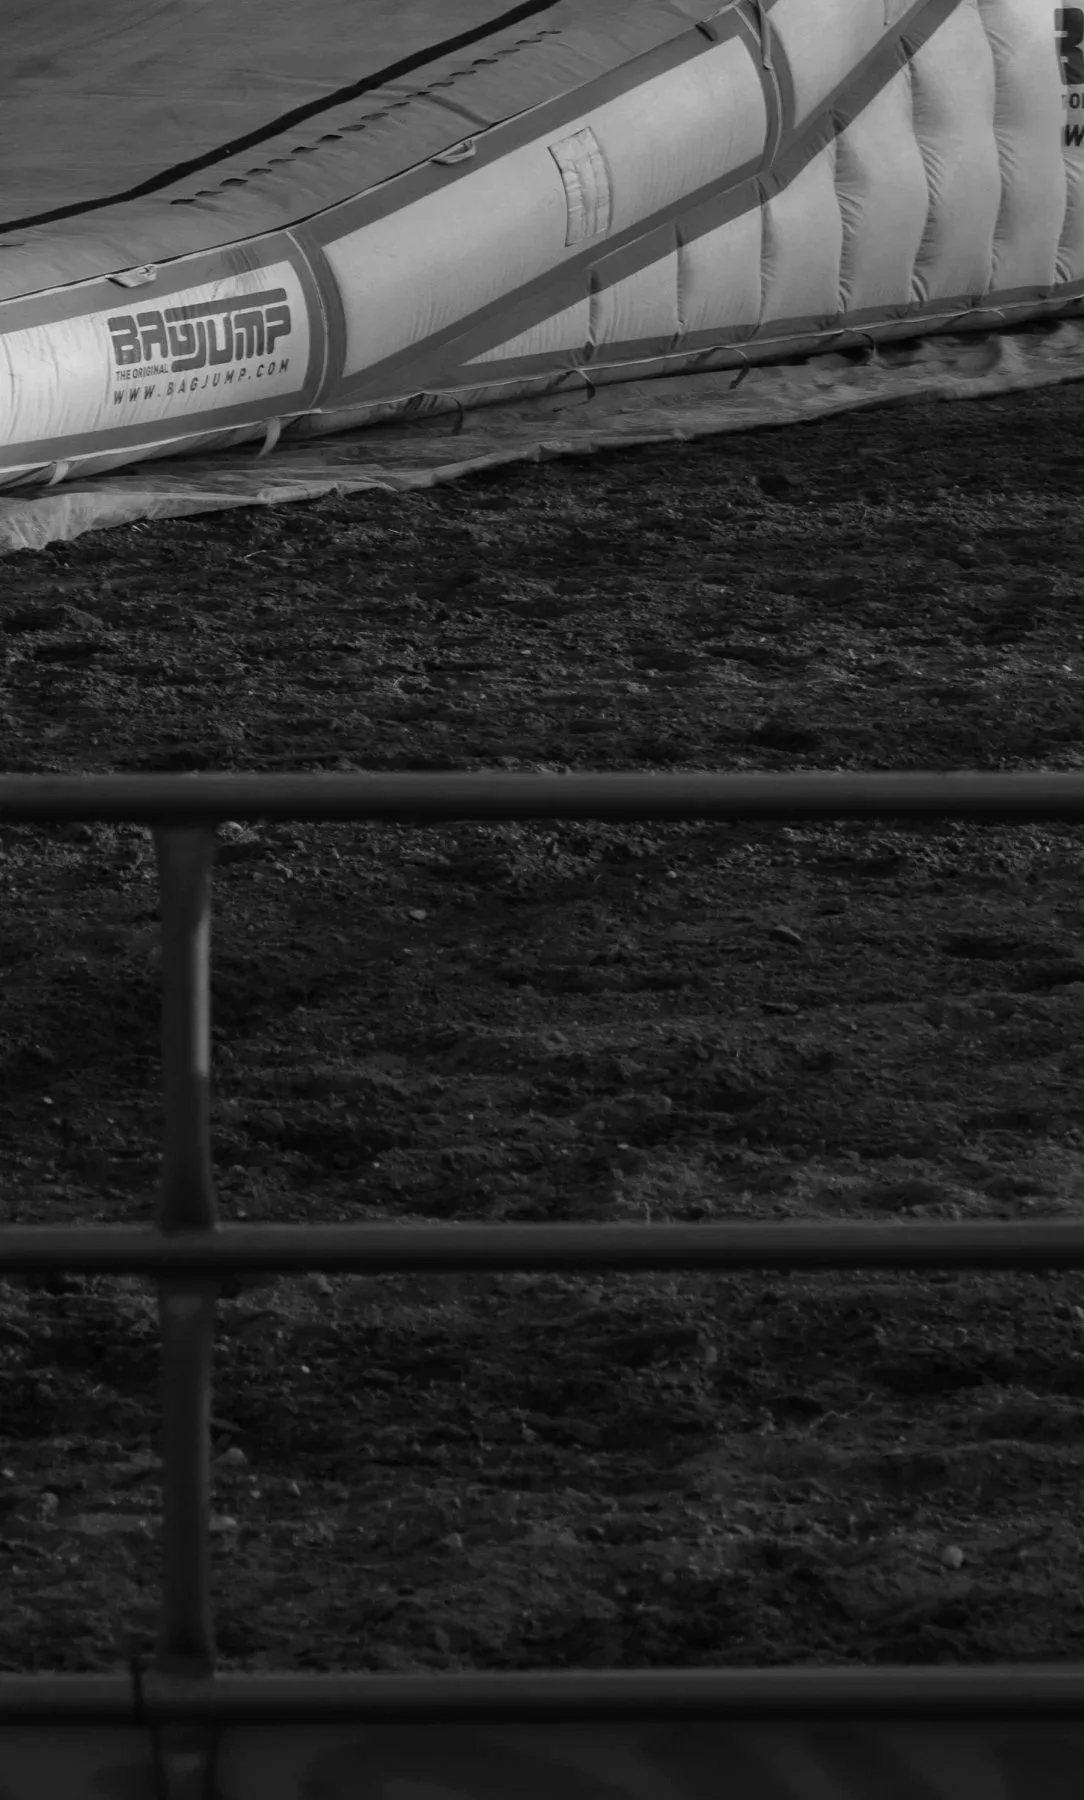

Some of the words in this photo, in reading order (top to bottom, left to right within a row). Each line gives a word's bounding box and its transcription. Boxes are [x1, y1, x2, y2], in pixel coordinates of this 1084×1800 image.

[107, 287, 292, 373] BAGJUMP
[113, 358, 290, 405] WWW.BAGJUMP.COM
[116, 368, 131, 381] THE
[132, 364, 169, 380] ORIGINAL
